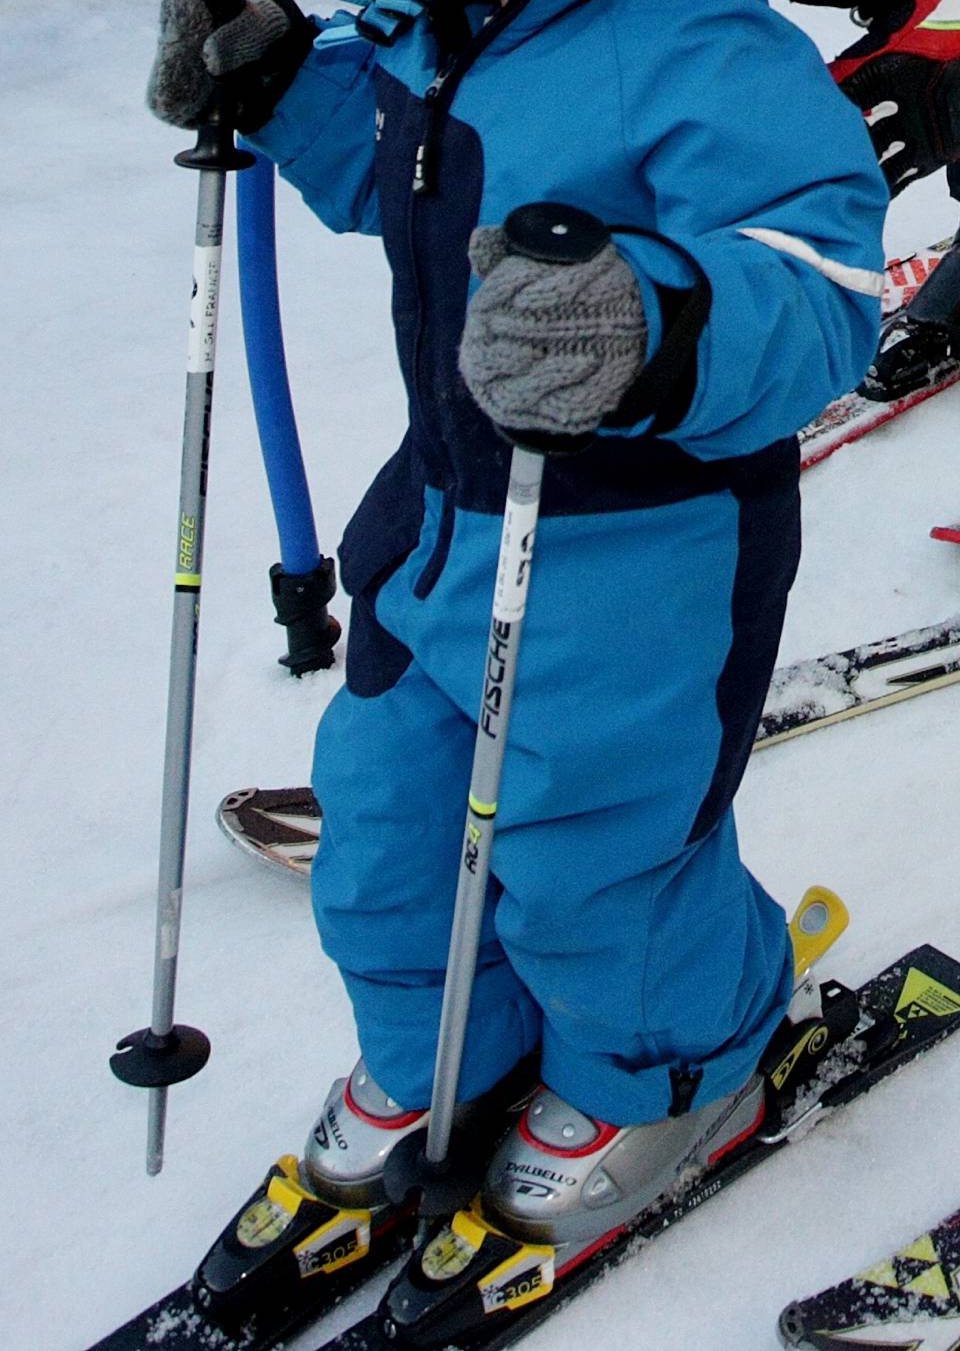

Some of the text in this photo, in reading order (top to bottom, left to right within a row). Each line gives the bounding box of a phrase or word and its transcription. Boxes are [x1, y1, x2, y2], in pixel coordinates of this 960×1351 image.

[179, 513, 196, 569] RACE
[504, 1161, 578, 1187] DALBELLO
[491, 1274, 542, 1305] C305
